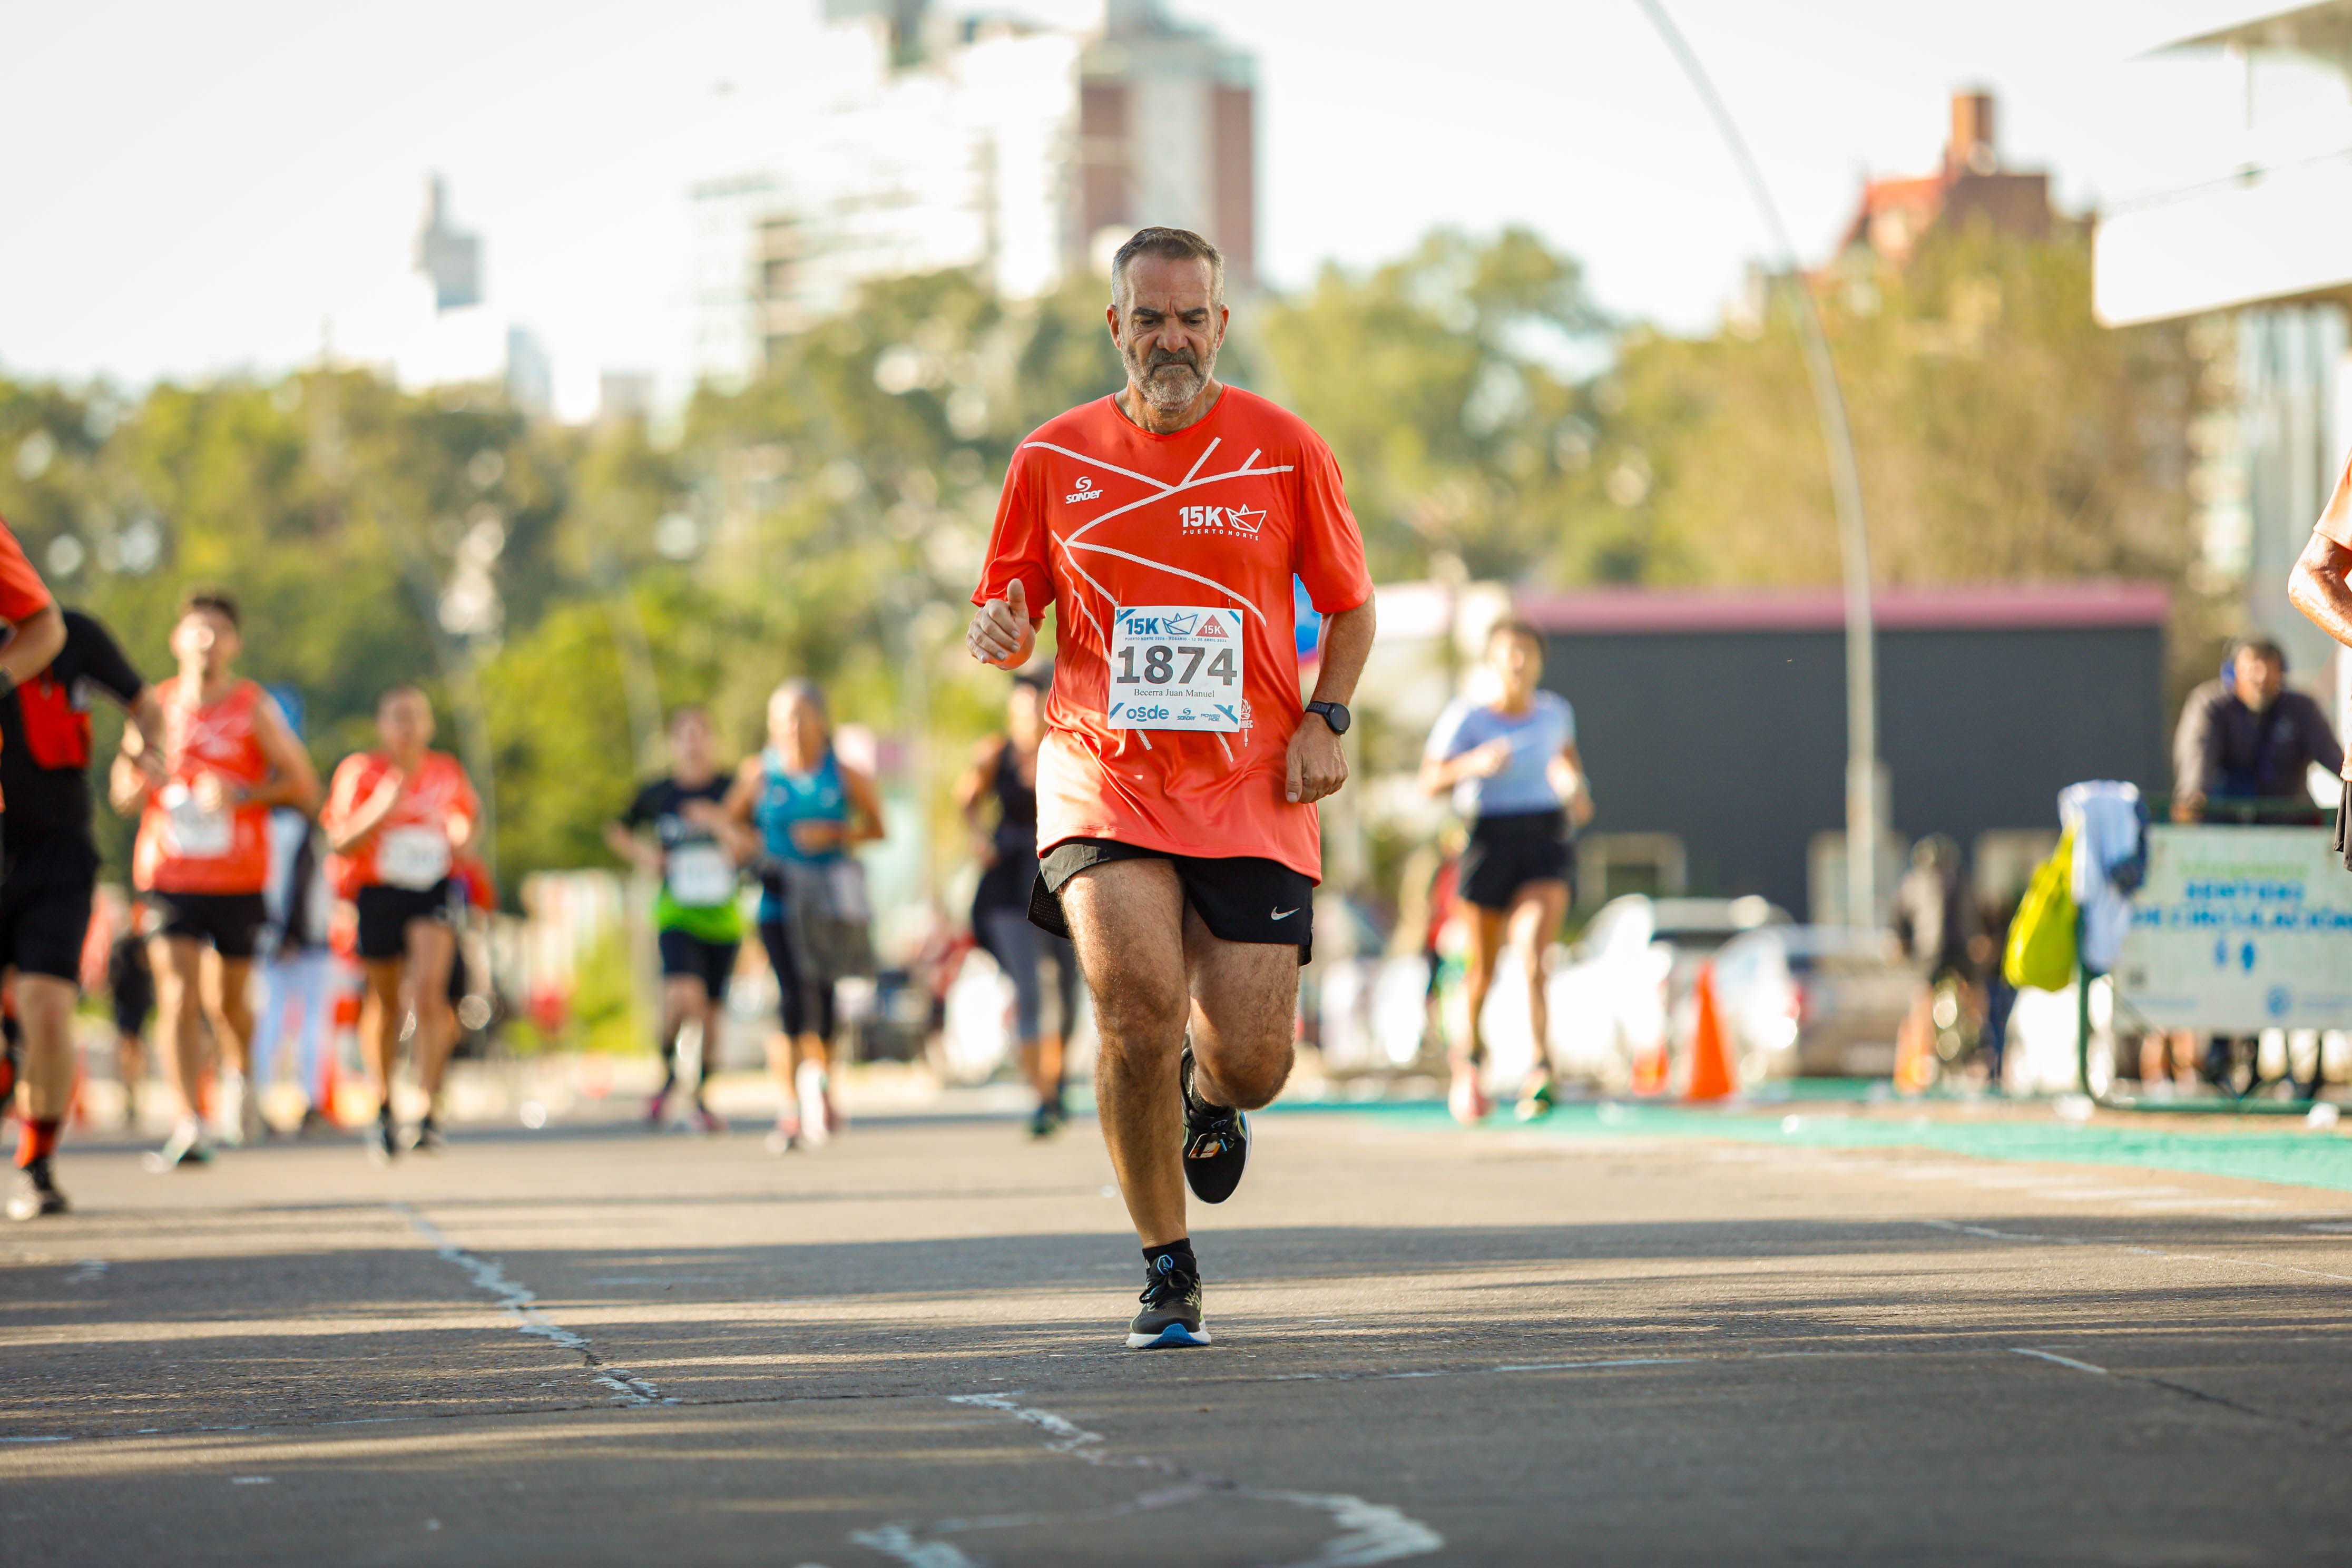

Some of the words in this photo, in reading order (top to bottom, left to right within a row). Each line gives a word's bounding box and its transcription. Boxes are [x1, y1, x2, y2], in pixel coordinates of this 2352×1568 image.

[1179, 506, 1224, 527] 15K
[1228, 530, 1259, 541] NORTE
[1126, 618, 1159, 635] 15K
[1203, 625, 1221, 634] 15K
[1116, 645, 1238, 686] 1874
[1185, 689, 1214, 698] Manuel
[1126, 704, 1170, 721] osde
